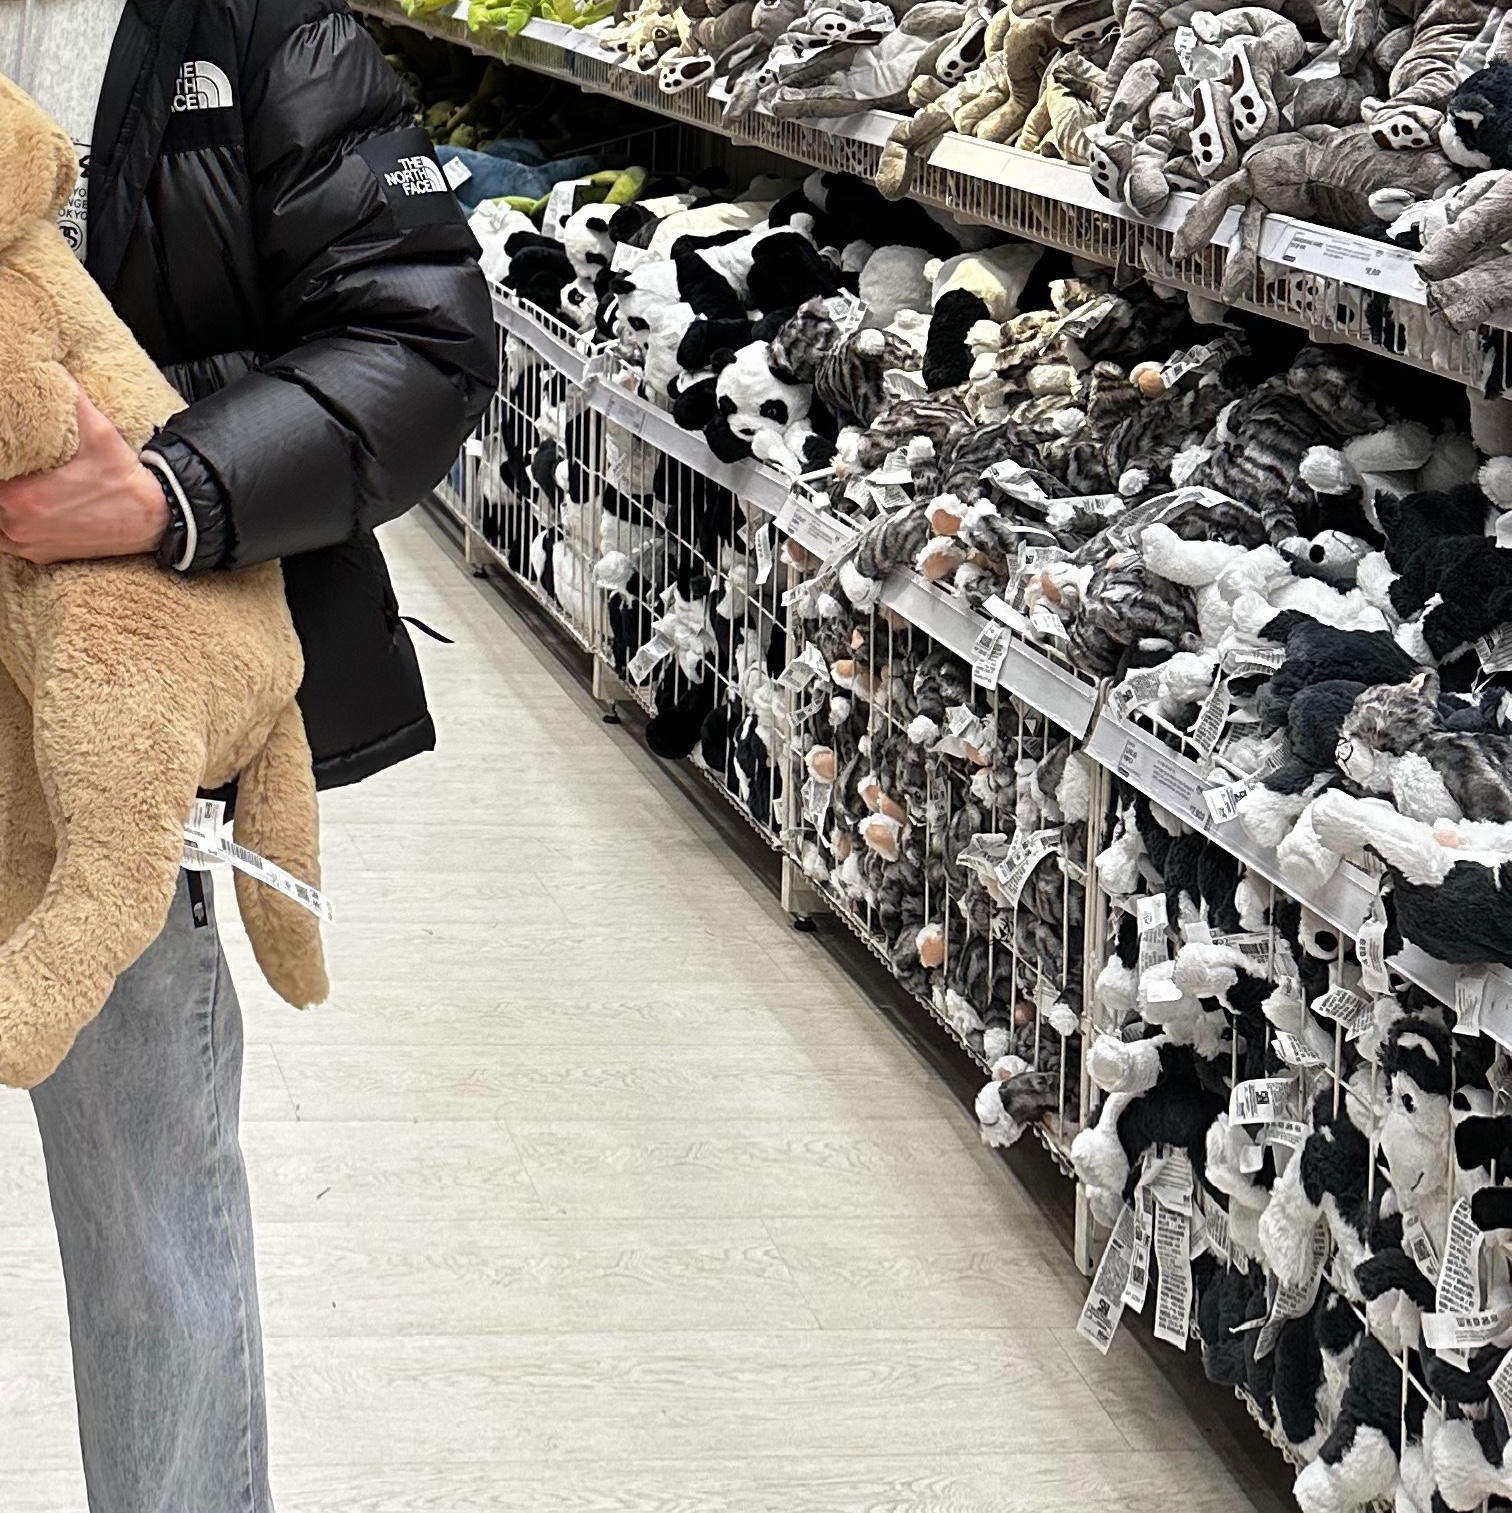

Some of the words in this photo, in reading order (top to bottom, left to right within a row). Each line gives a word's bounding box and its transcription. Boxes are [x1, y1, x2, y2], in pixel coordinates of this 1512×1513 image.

[397, 156, 423, 171] THE
[384, 168, 429, 186] NORTH
[402, 180, 433, 196] FACE
